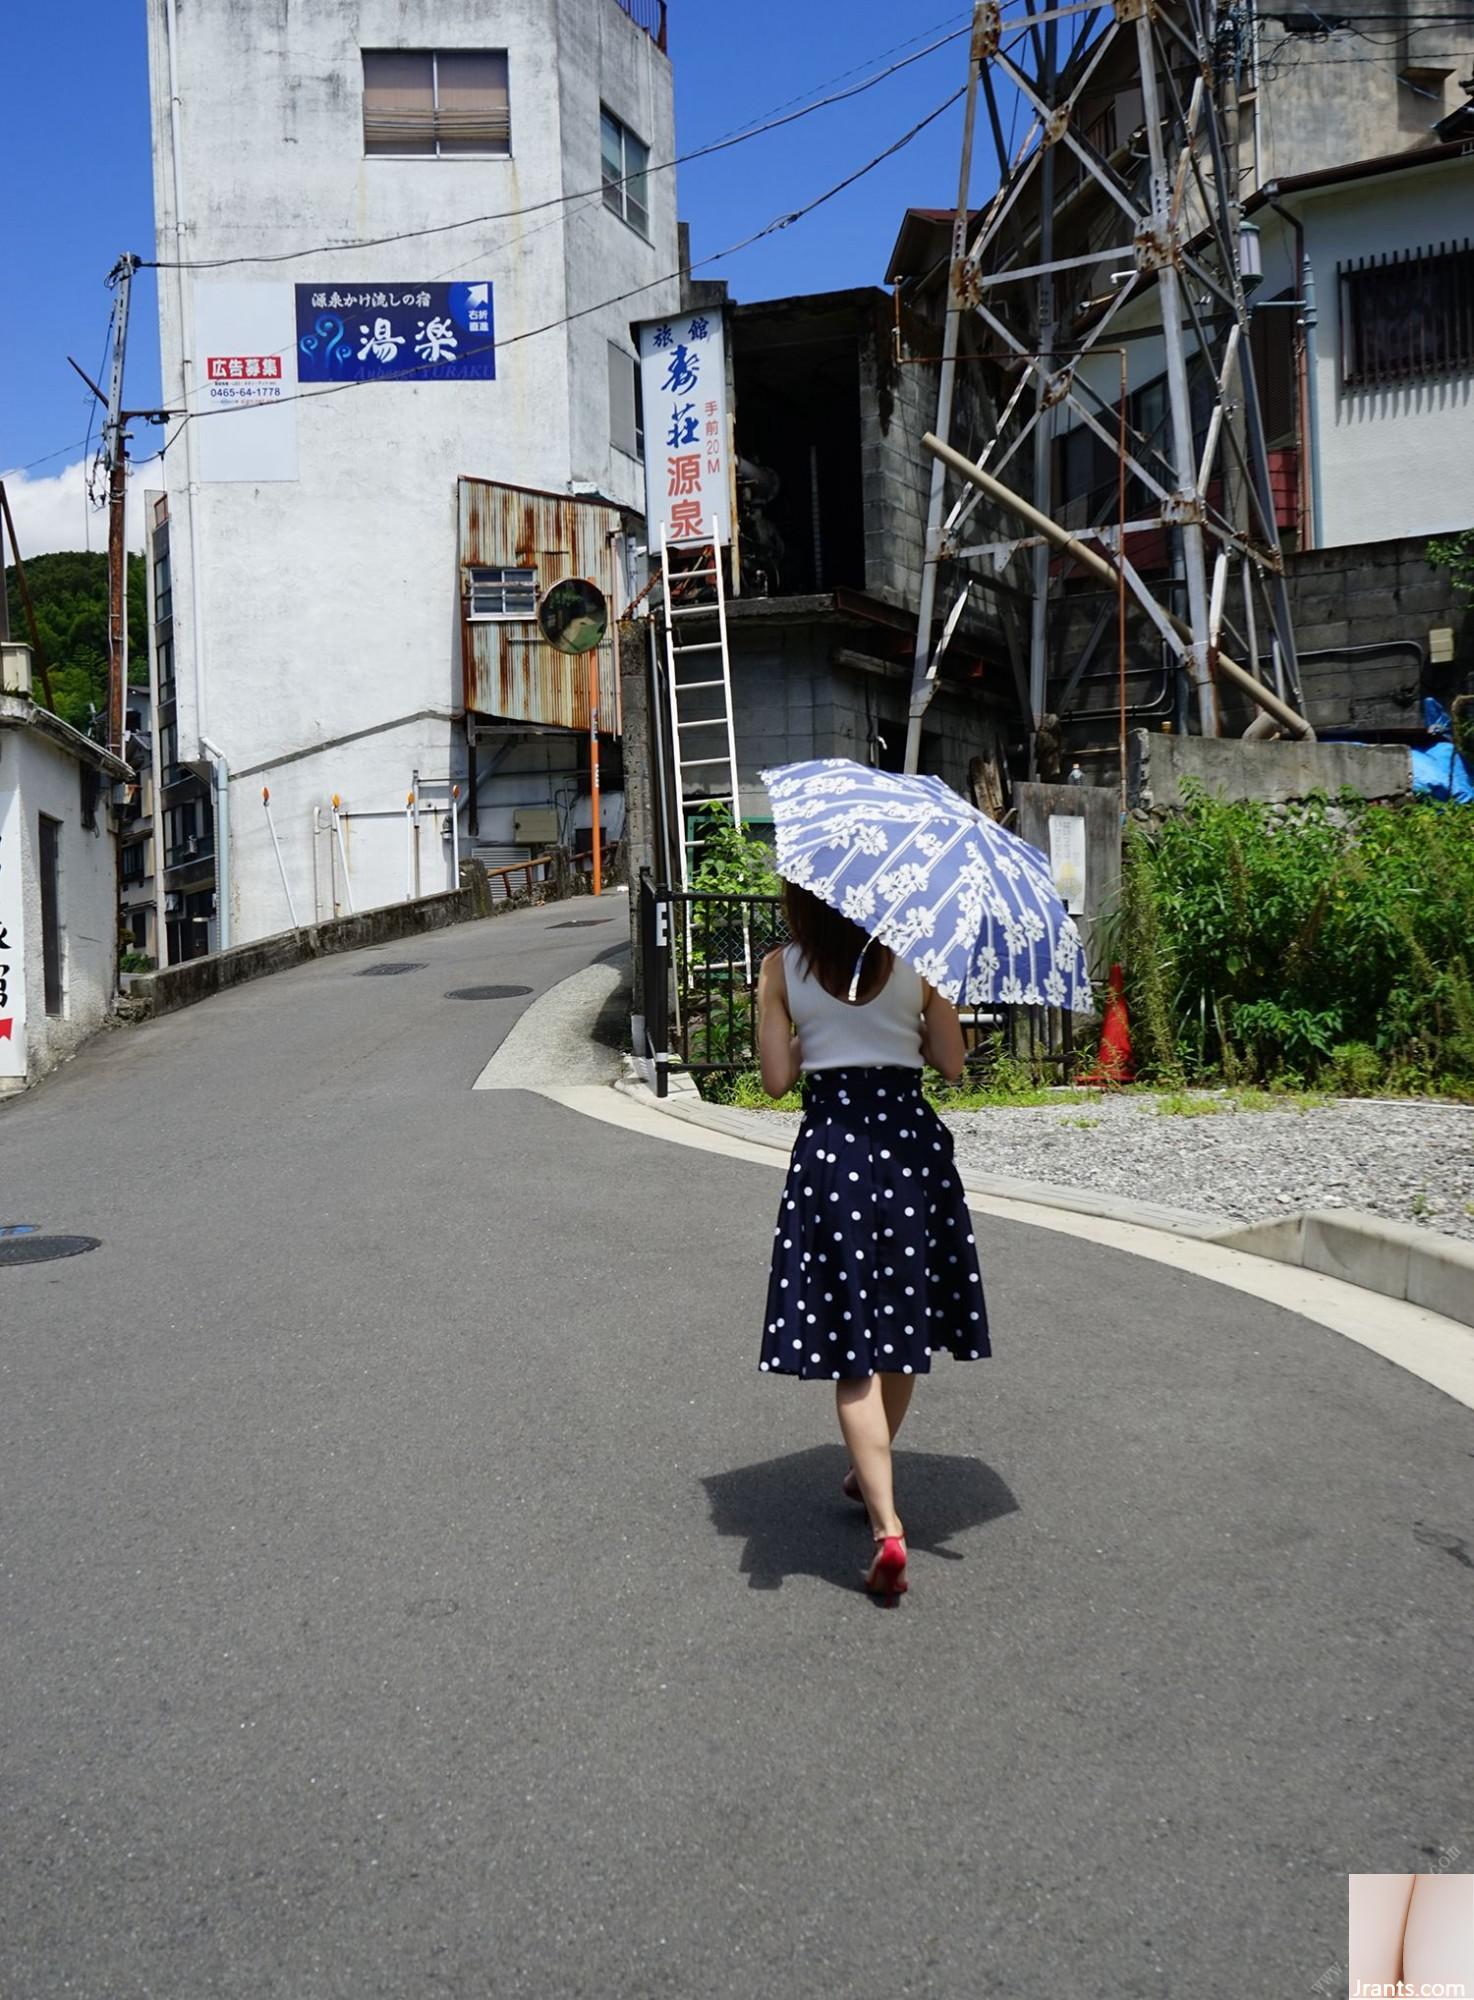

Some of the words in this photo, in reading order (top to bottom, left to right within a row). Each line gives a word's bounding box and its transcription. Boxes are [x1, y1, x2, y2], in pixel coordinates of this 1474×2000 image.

[312, 291, 431, 308] 源泉かけ流しの宿
[357, 316, 458, 363] 湯楽
[653, 317, 710, 348] 旅館
[212, 358, 277, 377] 広告募集
[210, 387, 281, 397] 0465-64-1778
[667, 454, 704, 538] 源泉
